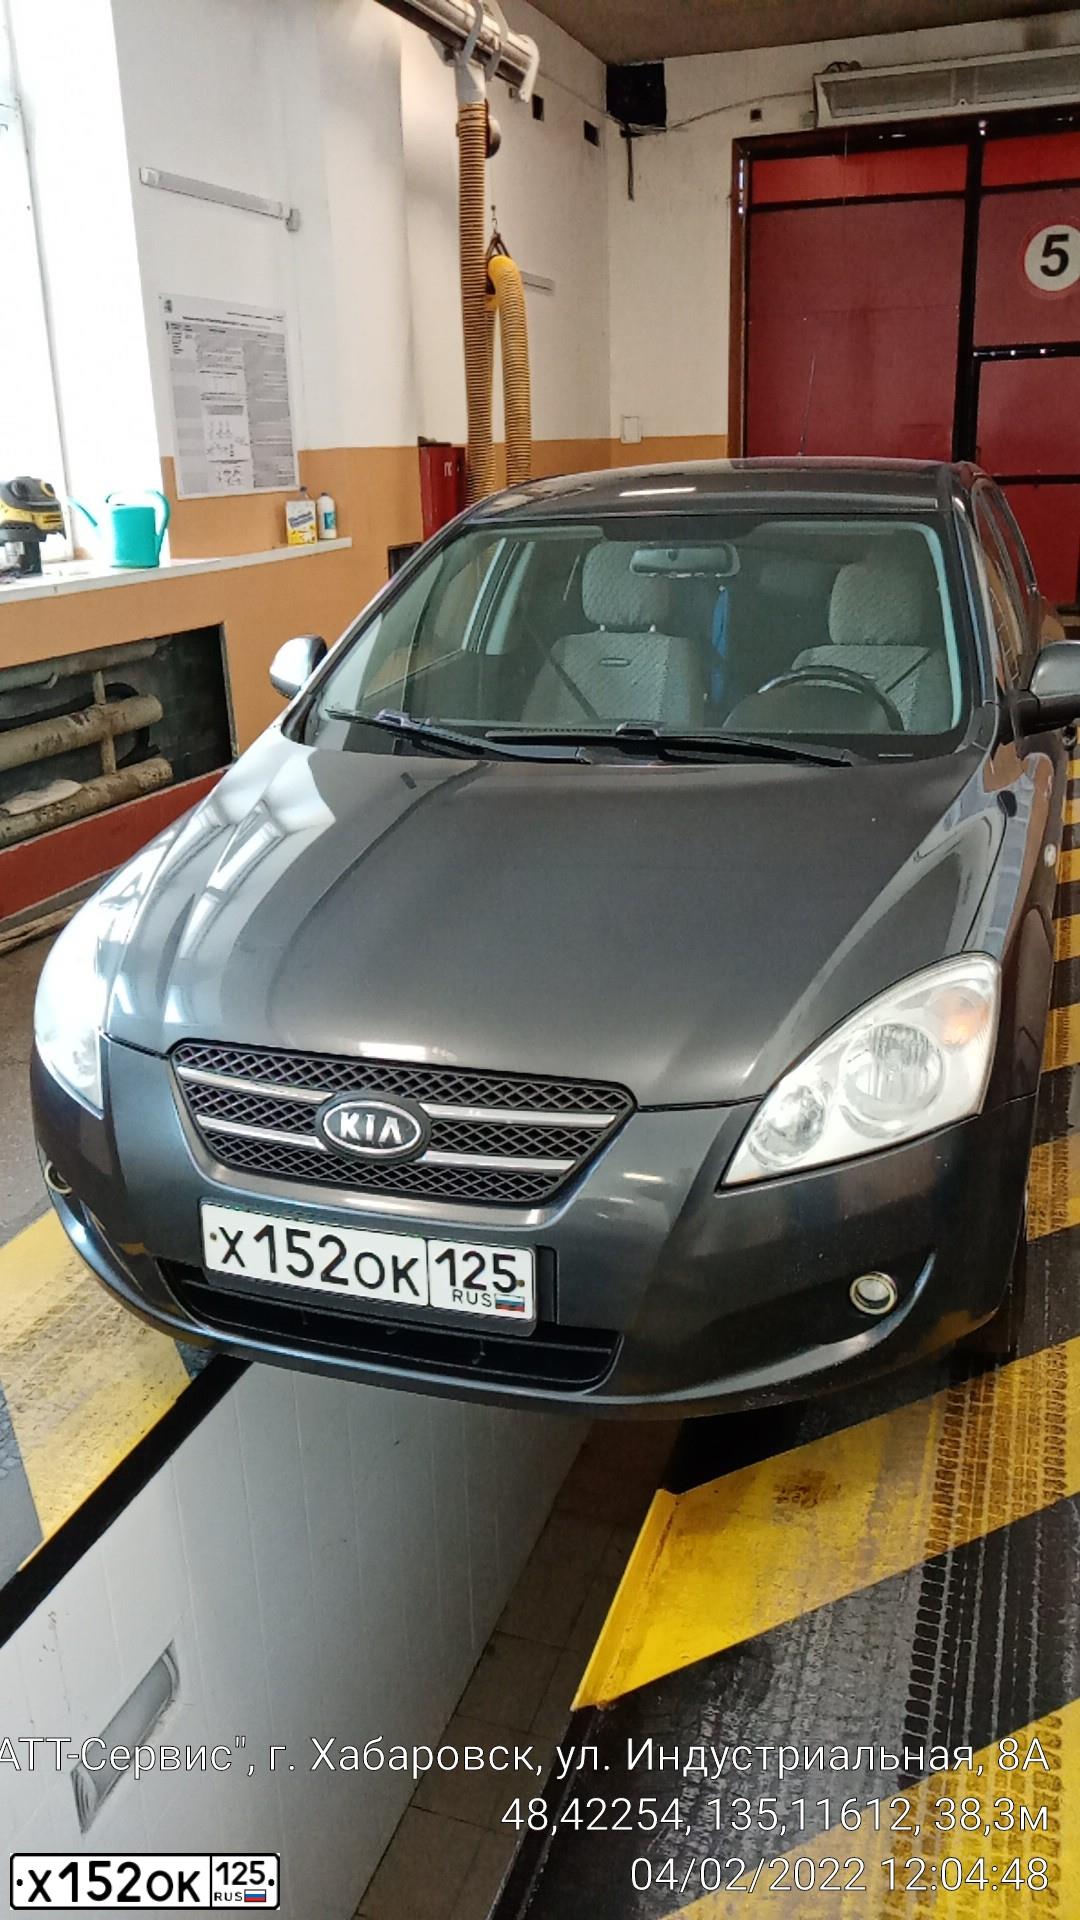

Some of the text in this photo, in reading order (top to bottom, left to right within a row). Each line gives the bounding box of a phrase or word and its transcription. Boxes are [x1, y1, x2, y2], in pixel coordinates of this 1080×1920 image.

[1040, 233, 1070, 277] 5
[339, 1112, 404, 1145] KIA
[435, 1248, 517, 1293] 125
[452, 1288, 493, 1308] RUS
